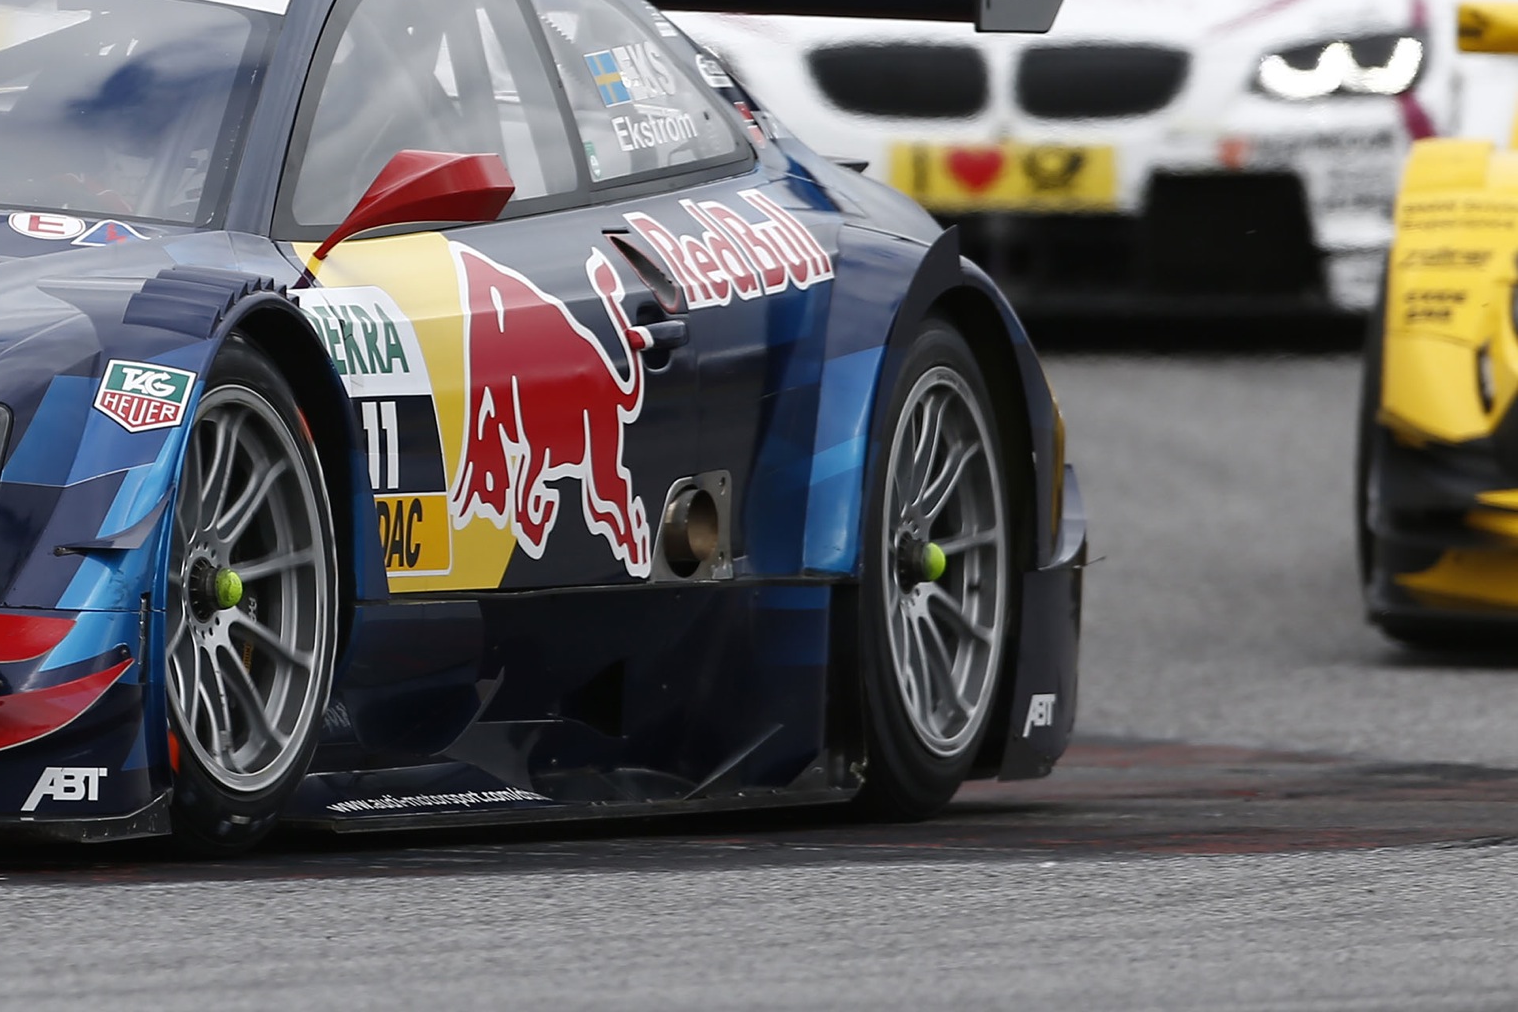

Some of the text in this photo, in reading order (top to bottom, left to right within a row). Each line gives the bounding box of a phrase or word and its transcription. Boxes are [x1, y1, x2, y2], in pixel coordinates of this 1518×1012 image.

[27, 214, 66, 235] E
[623, 188, 834, 309] Red Bull
[121, 367, 177, 398] TAG
[103, 393, 177, 426] HEUER
[361, 400, 400, 489] 11
[1023, 693, 1057, 738] ABT
[20, 766, 108, 812] ABT
